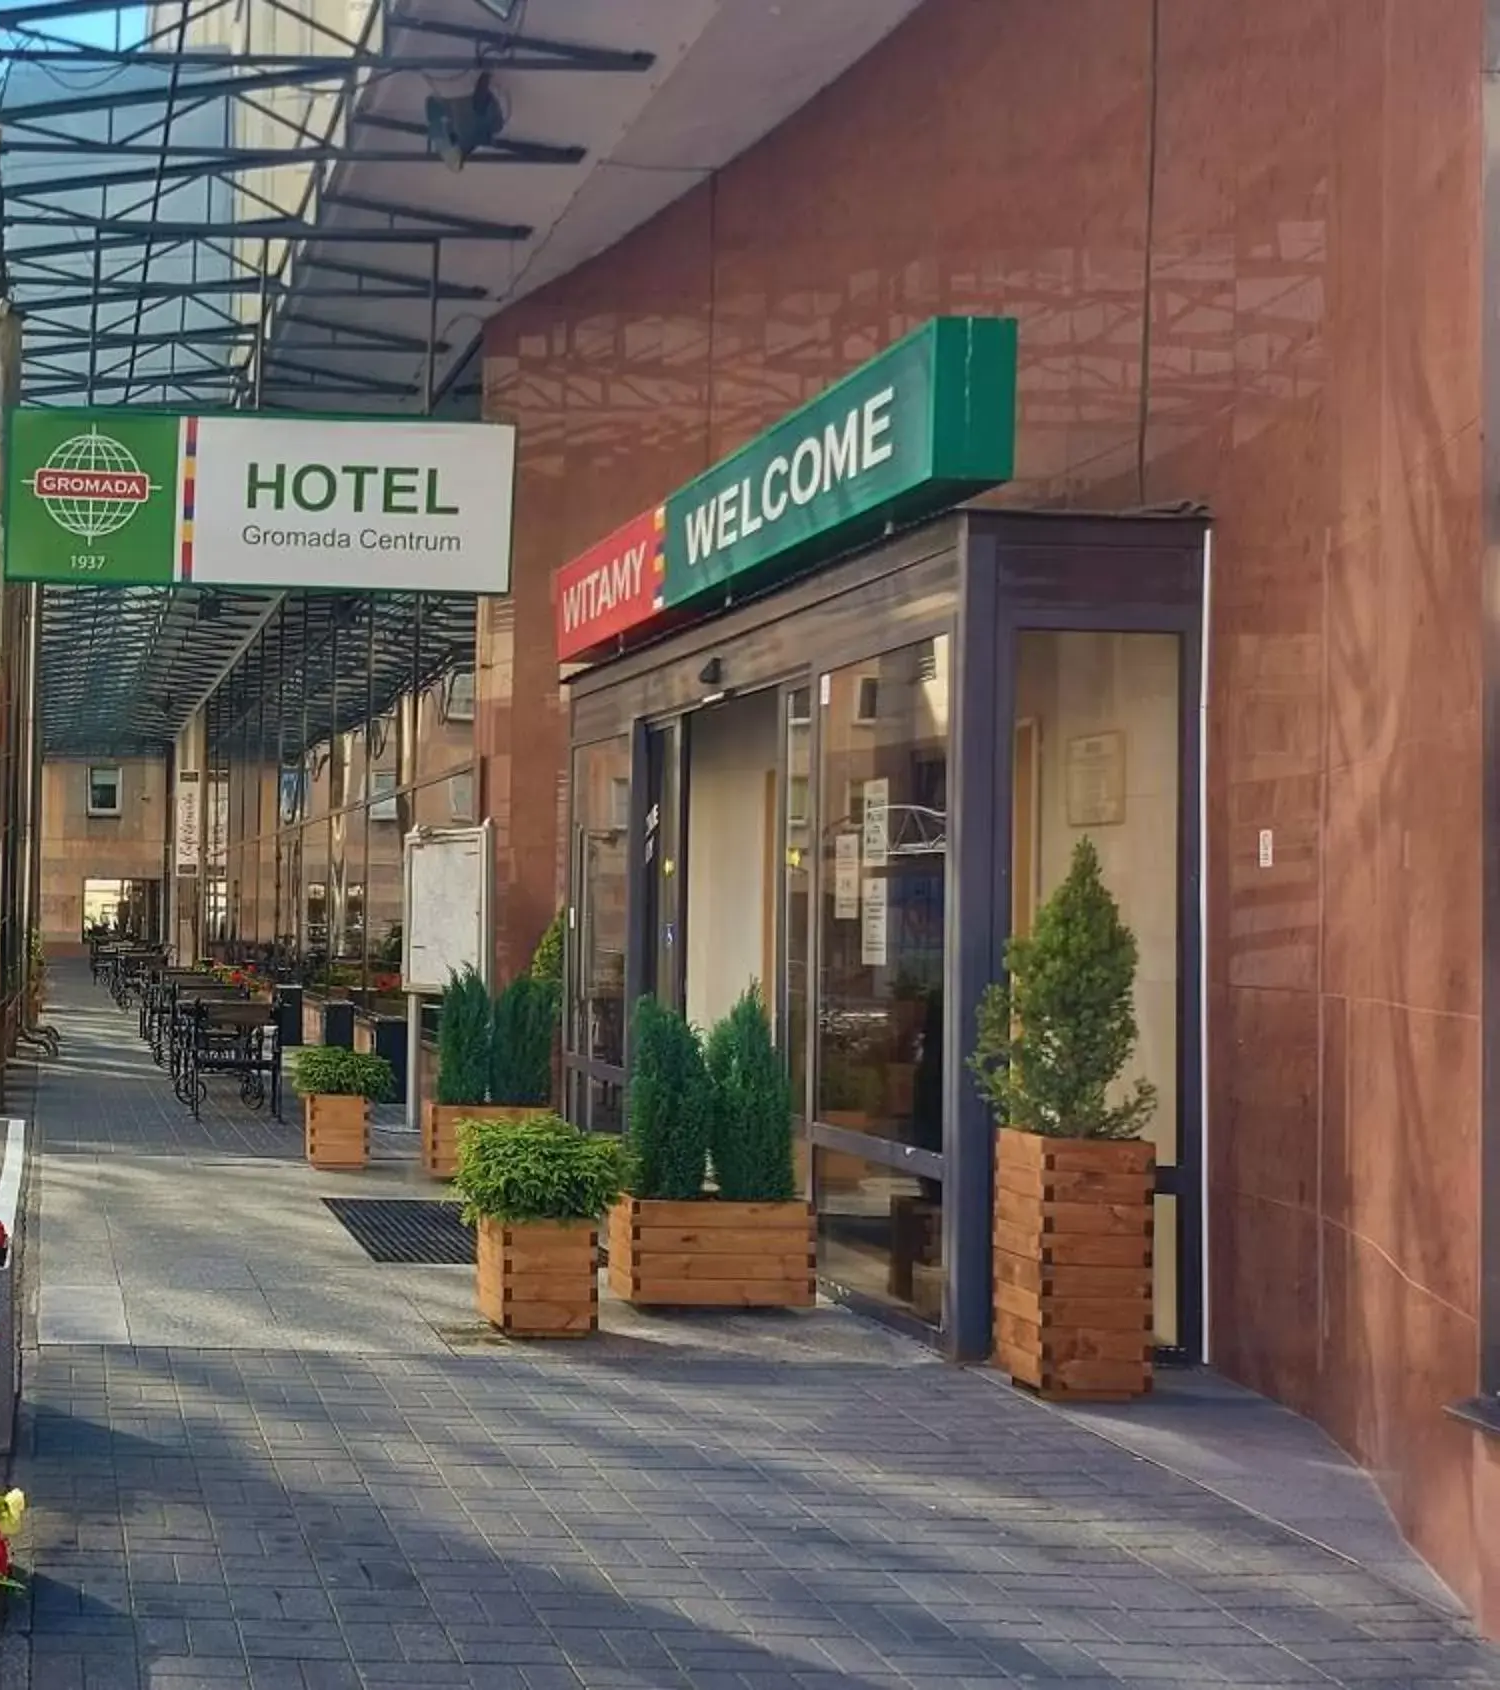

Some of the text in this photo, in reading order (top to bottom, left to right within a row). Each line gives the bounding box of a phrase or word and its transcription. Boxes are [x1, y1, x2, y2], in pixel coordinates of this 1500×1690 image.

[42, 475, 141, 496] GROMADA
[246, 462, 460, 515] HOTEL
[685, 387, 894, 566] WELCOME
[242, 525, 461, 553] Gromada Centrum
[70, 555, 106, 570] 1937
[562, 541, 647, 634] WITAMY
